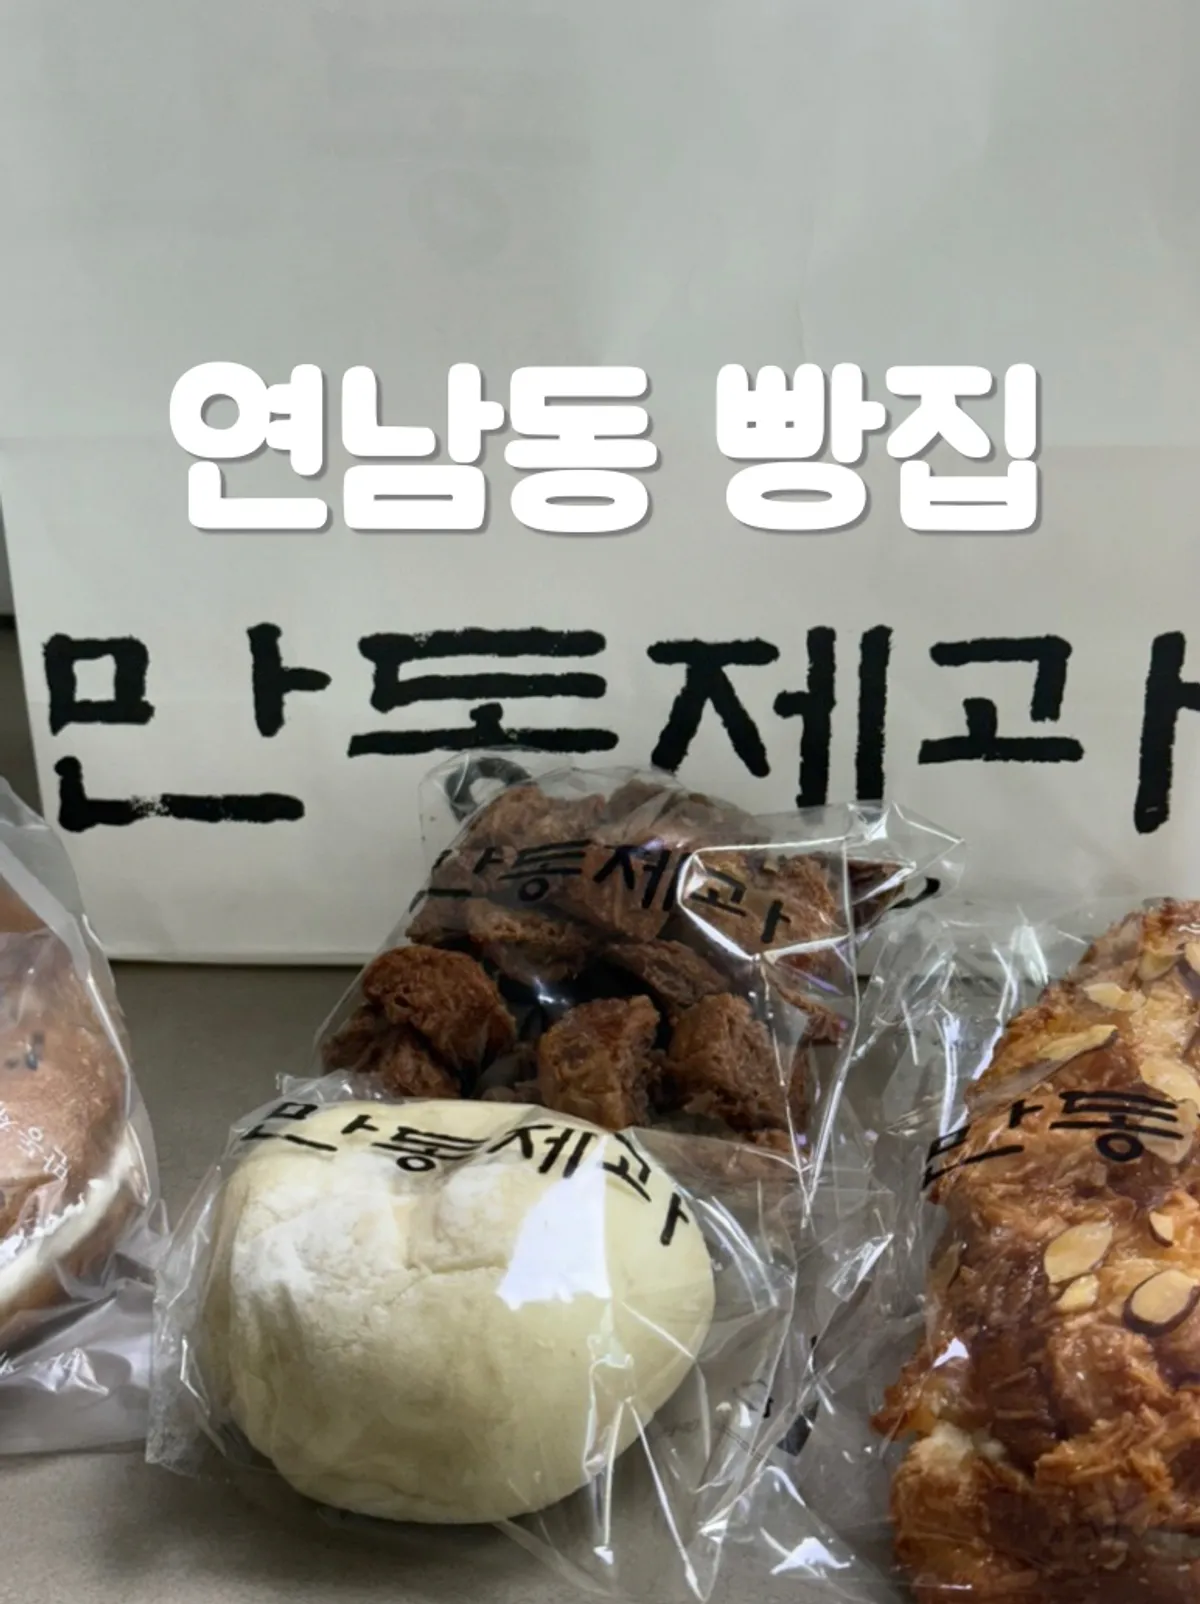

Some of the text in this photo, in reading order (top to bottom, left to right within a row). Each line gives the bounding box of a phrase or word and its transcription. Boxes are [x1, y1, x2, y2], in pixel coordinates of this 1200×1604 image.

[42, 622, 1200, 834] 만동제과
[240, 1101, 690, 1247] 만동제과
[922, 1090, 1200, 1192] 만동
